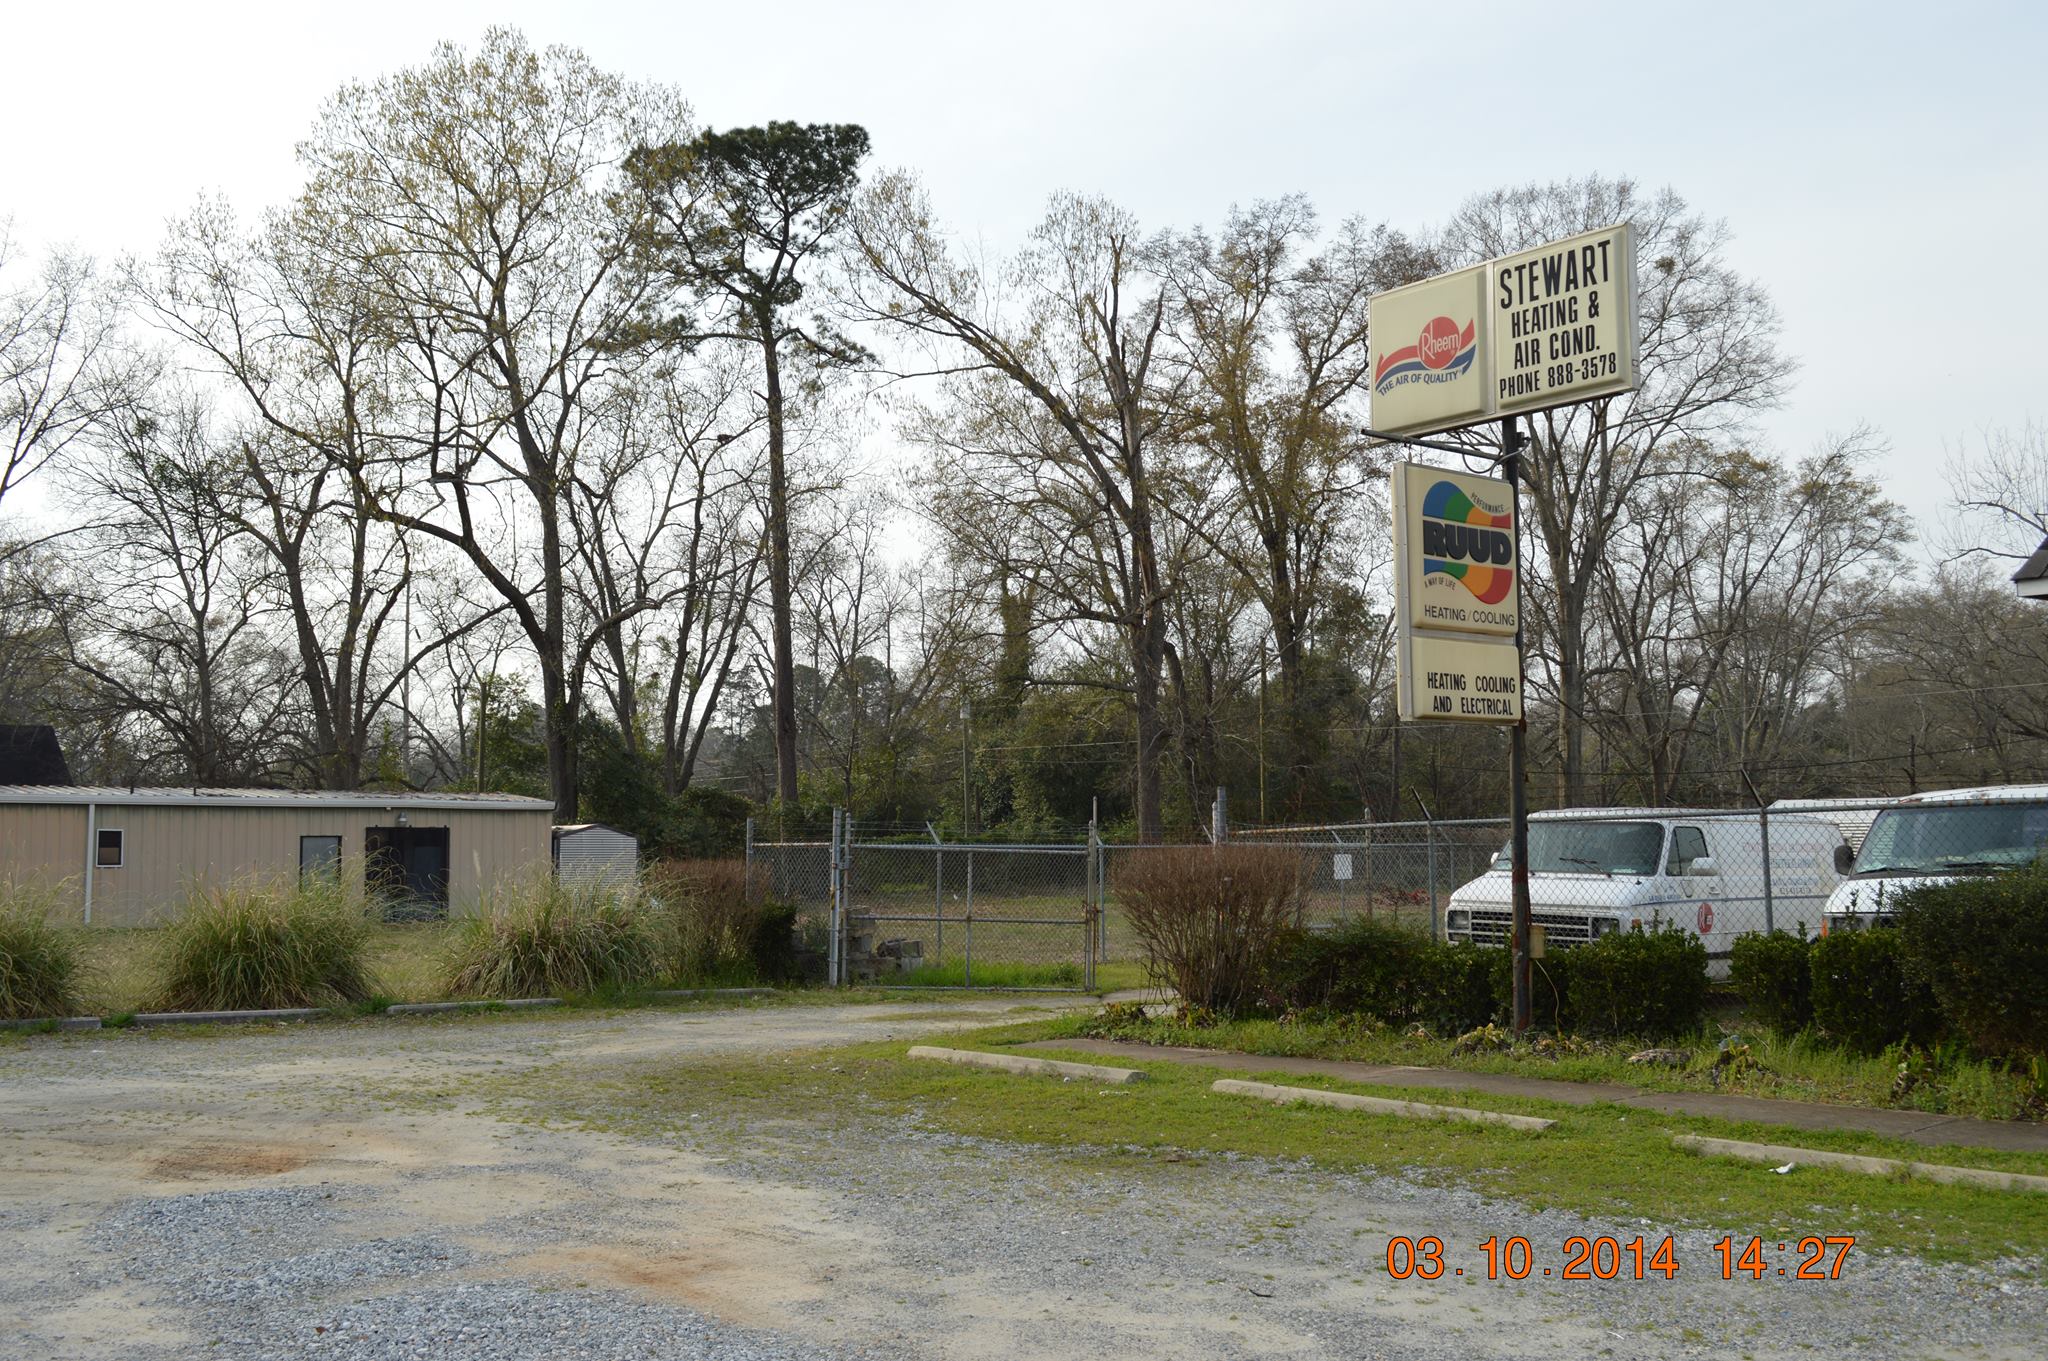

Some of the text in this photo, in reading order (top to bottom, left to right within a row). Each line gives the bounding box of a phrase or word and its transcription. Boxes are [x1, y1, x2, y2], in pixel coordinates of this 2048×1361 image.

[1500, 239, 1611, 309] STEWART
[1511, 290, 1599, 339] HEATING &
[1421, 321, 1459, 361] Rheem
[1514, 324, 1600, 370] AIR COND.
[1378, 370, 1459, 396] THE AIR OF QUALITY
[1500, 352, 1616, 399] PHONE 888-3578
[1470, 492, 1505, 513] PERFORMANCE
[1422, 520, 1512, 566] RUUD
[1428, 578, 1438, 587] WAY
[1438, 576, 1444, 585] OF
[1444, 577, 1456, 591] LIFE
[1427, 671, 1515, 694] HEATING COOLING
[1433, 695, 1513, 716] AND ELECTRICAL
